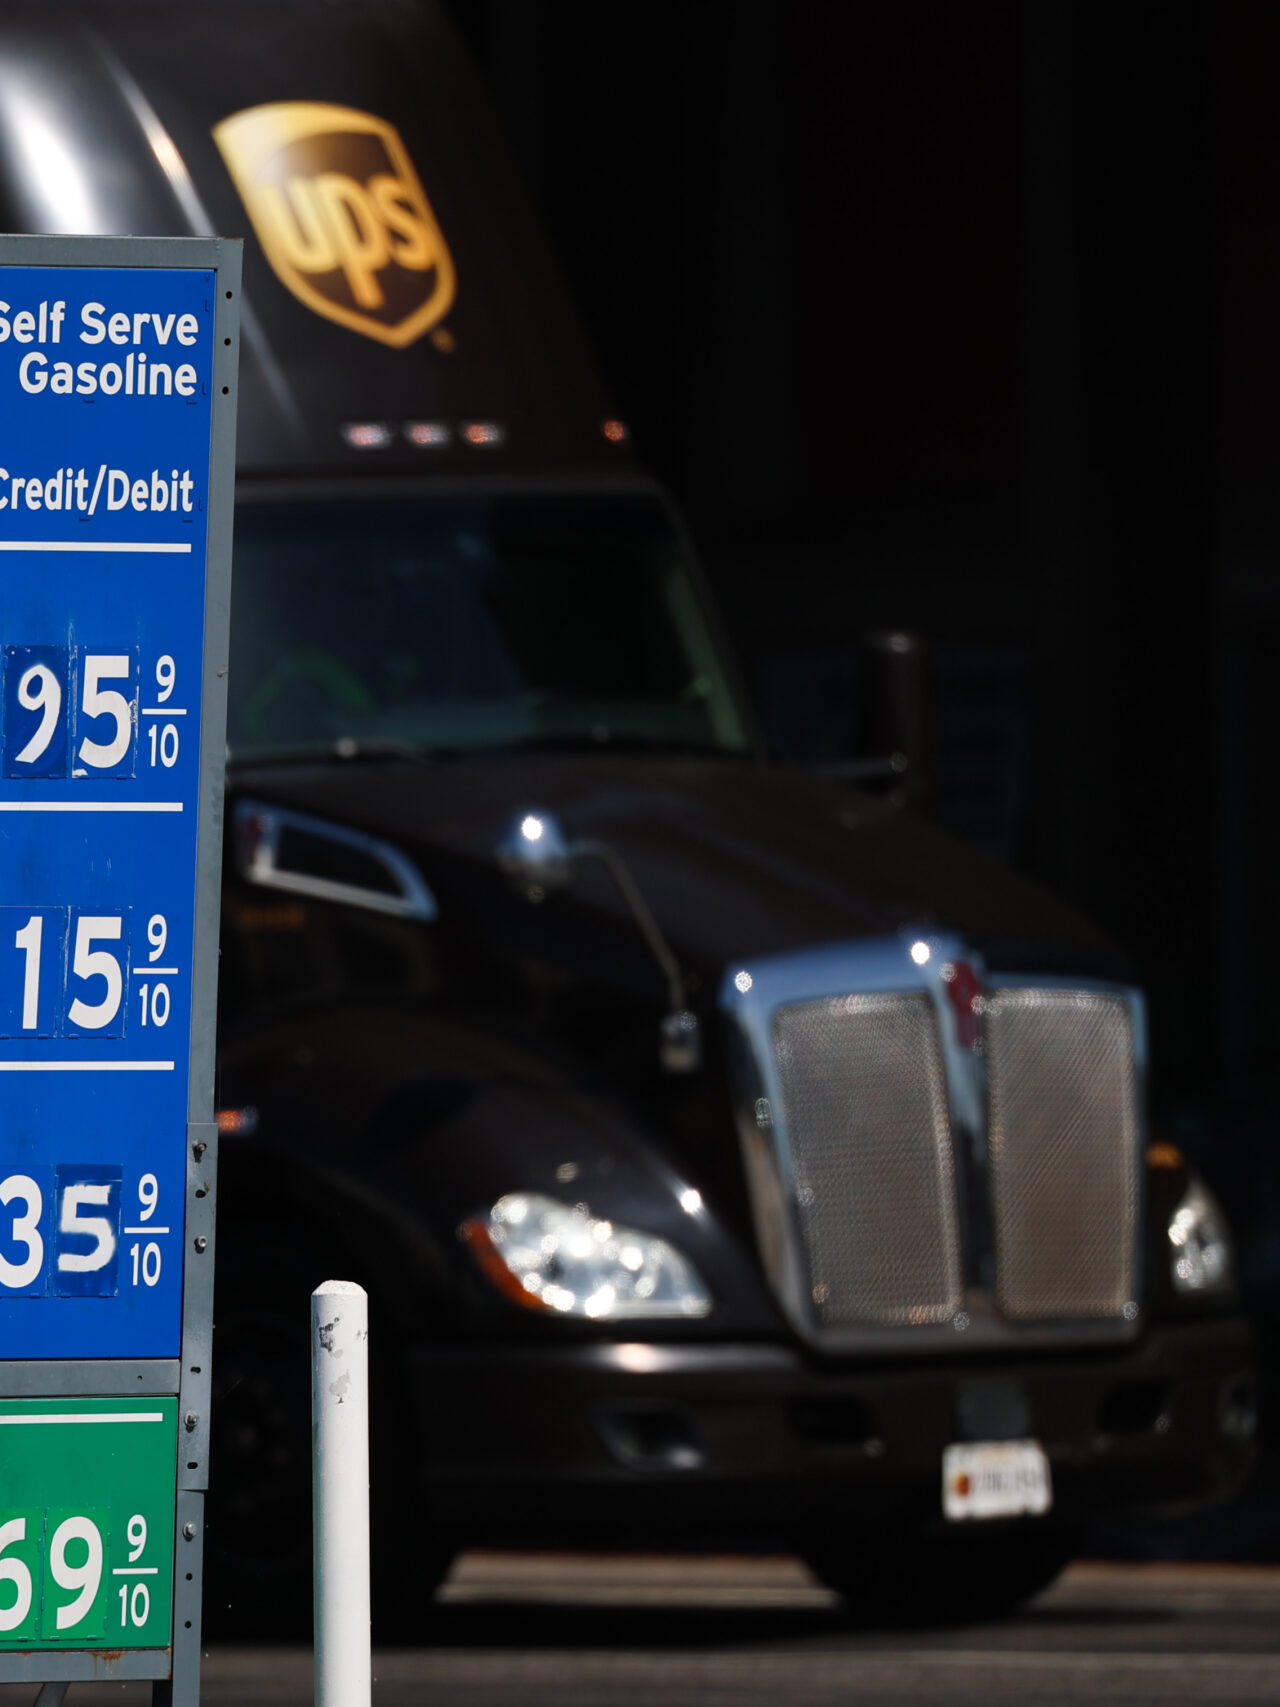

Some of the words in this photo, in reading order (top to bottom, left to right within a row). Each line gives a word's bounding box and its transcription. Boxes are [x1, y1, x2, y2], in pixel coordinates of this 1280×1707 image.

[258, 172, 438, 310] ups
[79, 301, 199, 346] Serve
[19, 351, 197, 396] Gasoline
